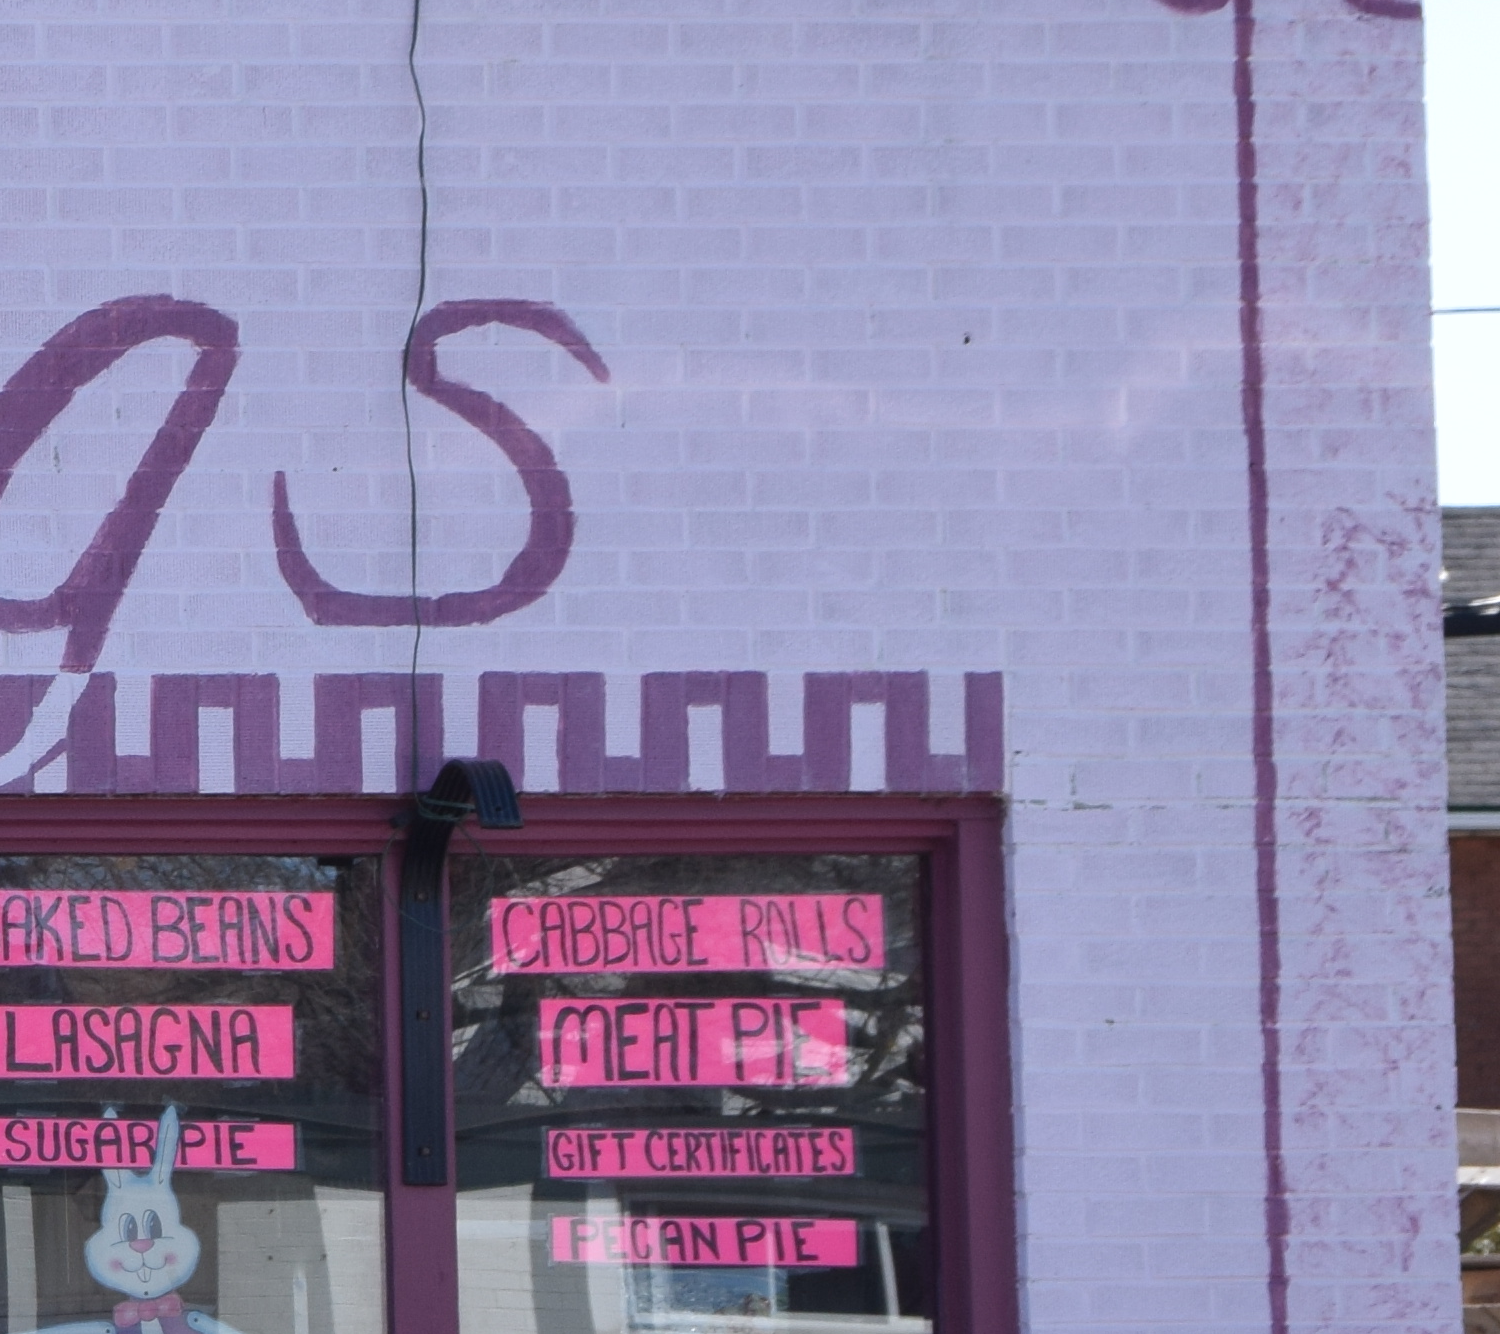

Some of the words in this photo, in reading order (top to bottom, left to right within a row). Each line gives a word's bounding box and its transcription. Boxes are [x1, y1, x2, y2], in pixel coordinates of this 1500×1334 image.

[150, 895, 314, 963] BEANS
[501, 899, 706, 969] CABBAGE
[740, 897, 872, 966] ROLLS
[3, 1009, 261, 1076] LASAGNA
[552, 1003, 708, 1084] MEAT
[732, 1001, 832, 1083] PIE
[5, 1119, 155, 1166] SUGAR
[179, 1122, 258, 1166] PIE
[551, 1131, 634, 1172] GIFT
[645, 1129, 848, 1174] CERTIFICATES
[570, 1221, 719, 1262] PECAN
[737, 1220, 818, 1262] PIE
